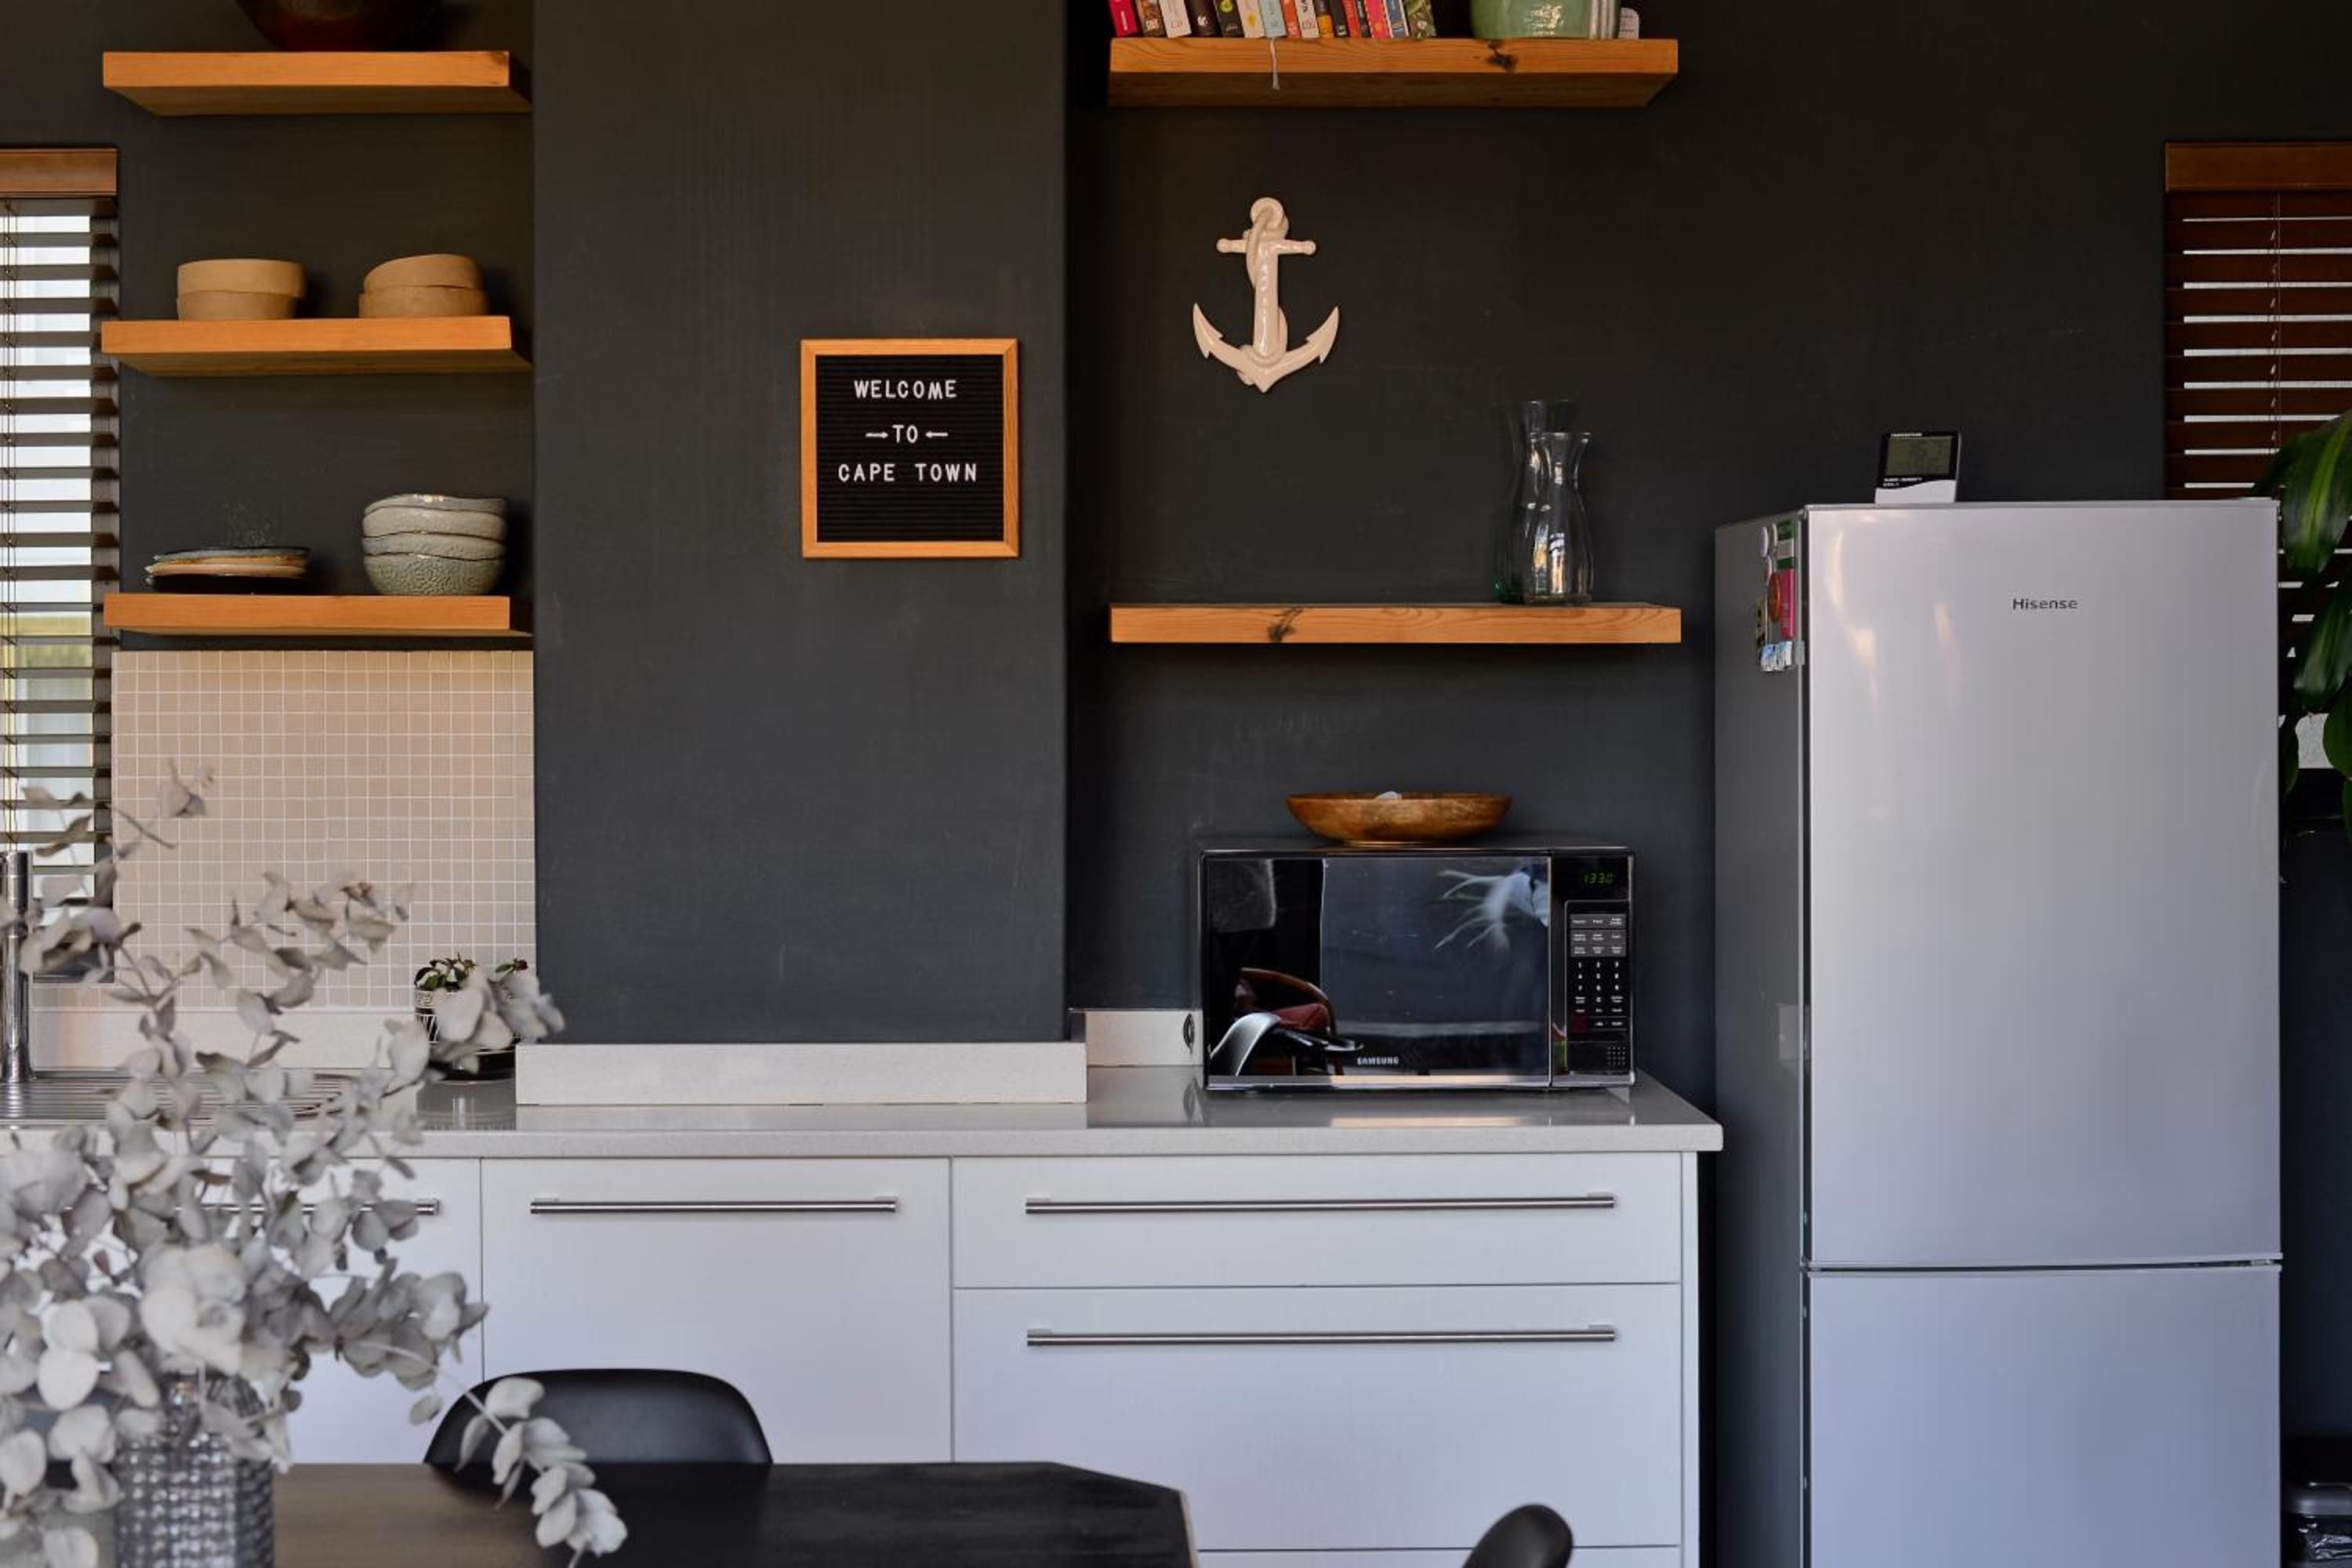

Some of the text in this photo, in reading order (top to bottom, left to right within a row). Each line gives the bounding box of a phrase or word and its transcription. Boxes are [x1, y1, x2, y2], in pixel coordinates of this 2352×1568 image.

[854, 379, 957, 400] WELCOME
[892, 424, 919, 444] TO
[838, 463, 977, 482] CAPE TOWN
[2013, 598, 2078, 610] Hisense
[1356, 1057, 1399, 1065] SAMSUNG
